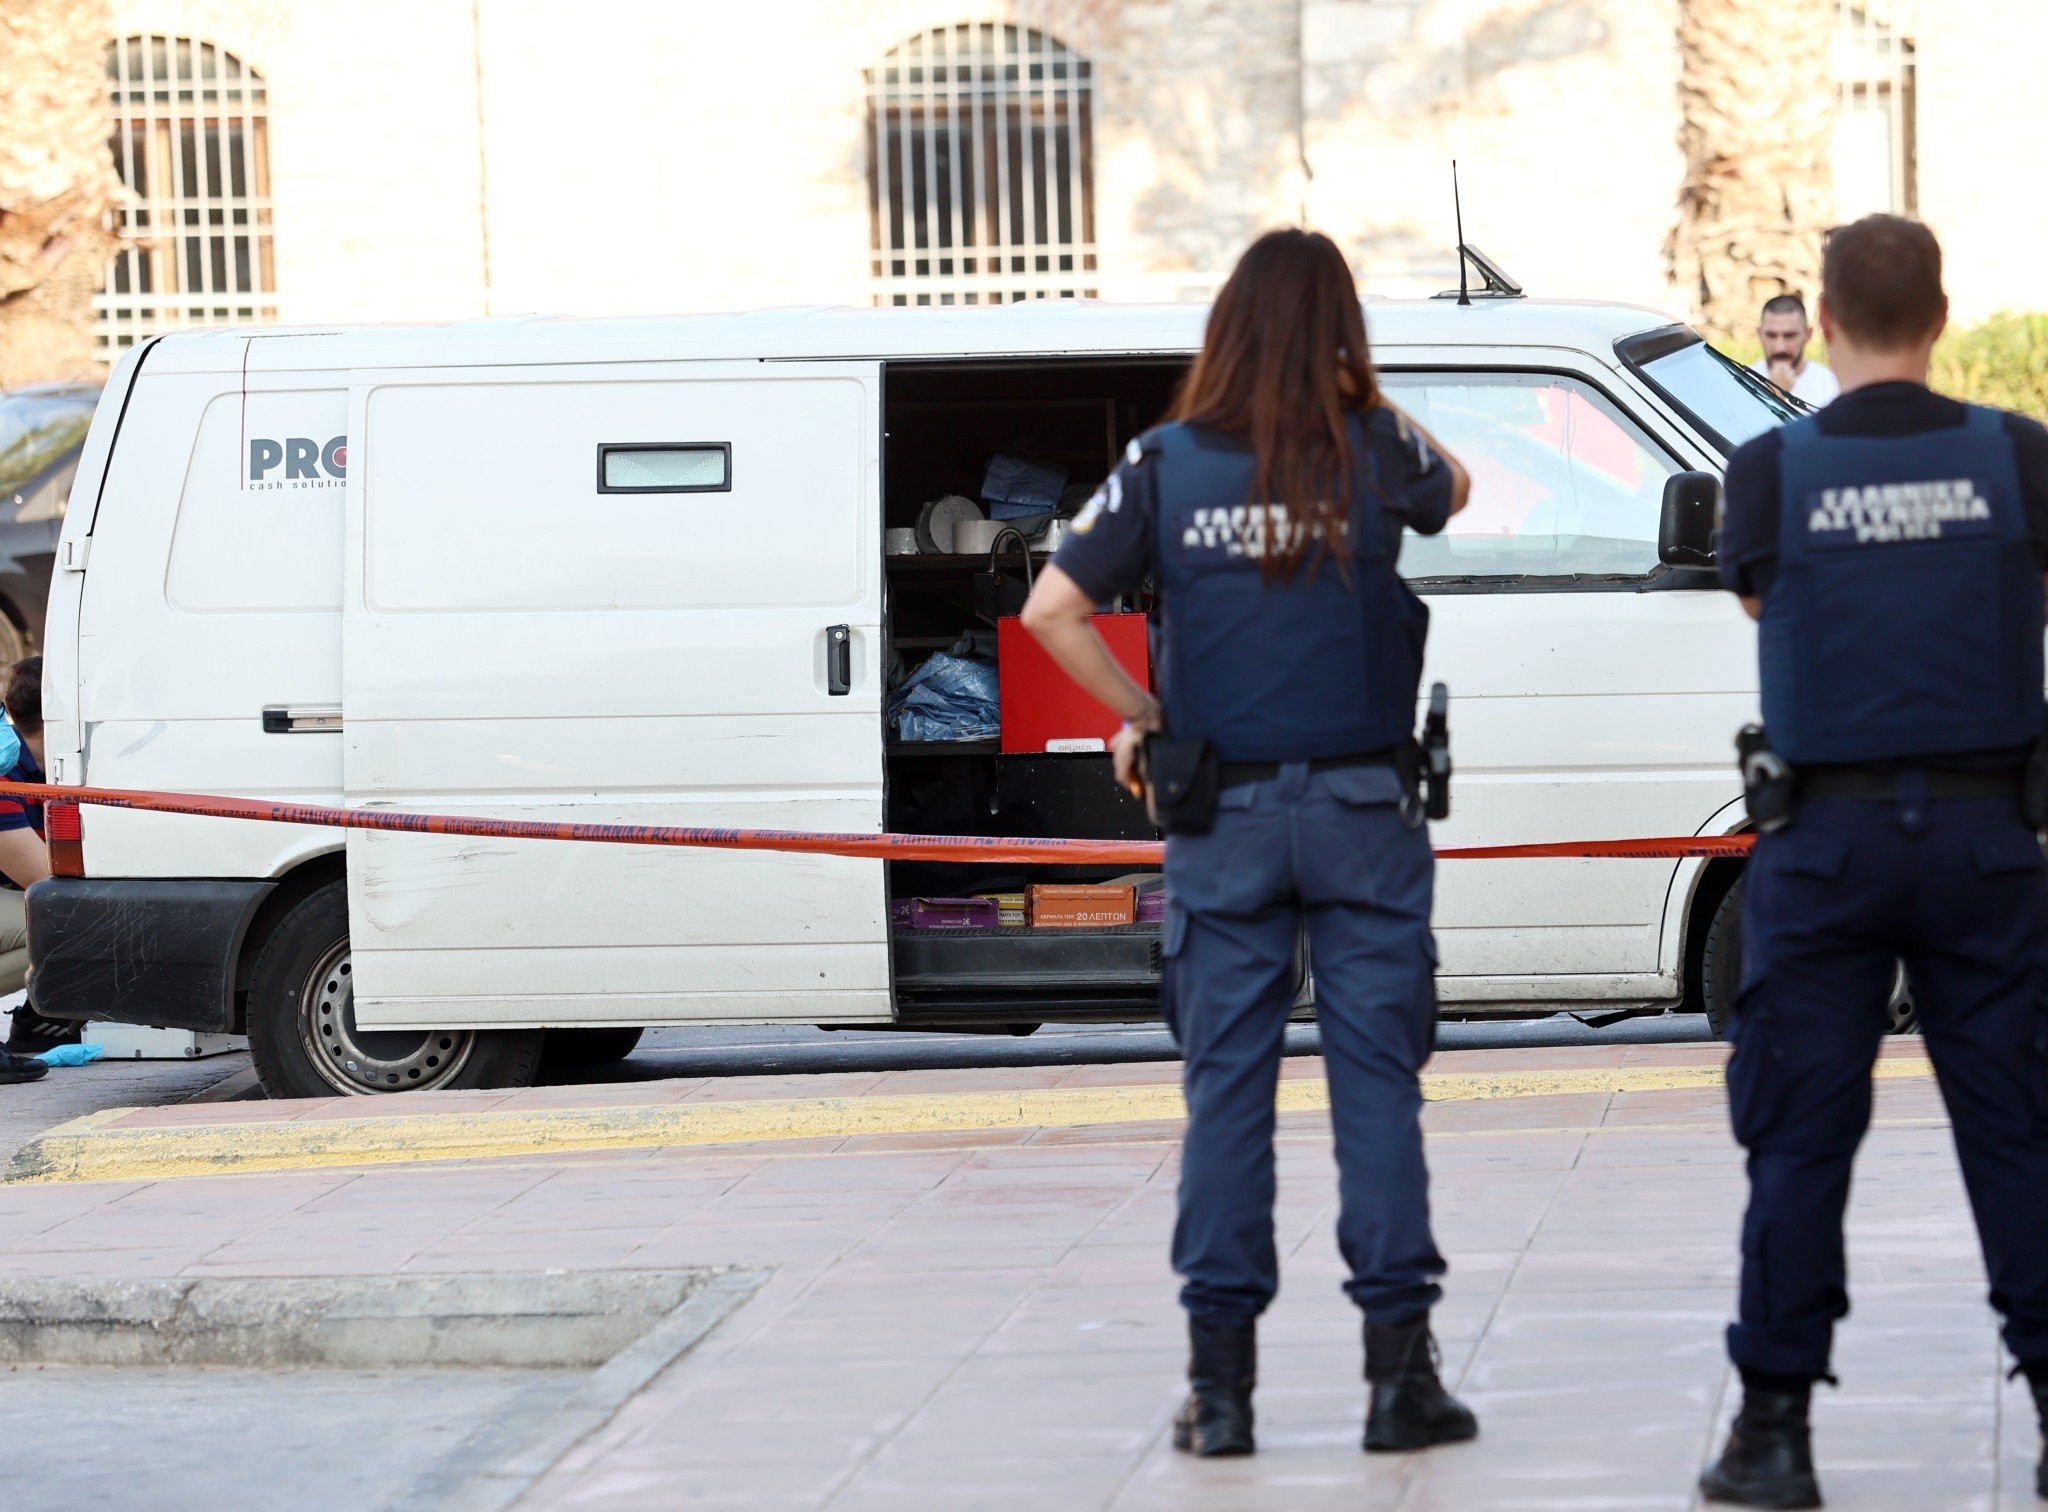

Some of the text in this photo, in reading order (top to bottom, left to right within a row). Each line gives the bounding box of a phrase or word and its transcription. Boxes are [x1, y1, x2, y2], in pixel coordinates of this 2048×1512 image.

[249, 480, 347, 491] cash solutio
[1076, 912, 1088, 921] 20
